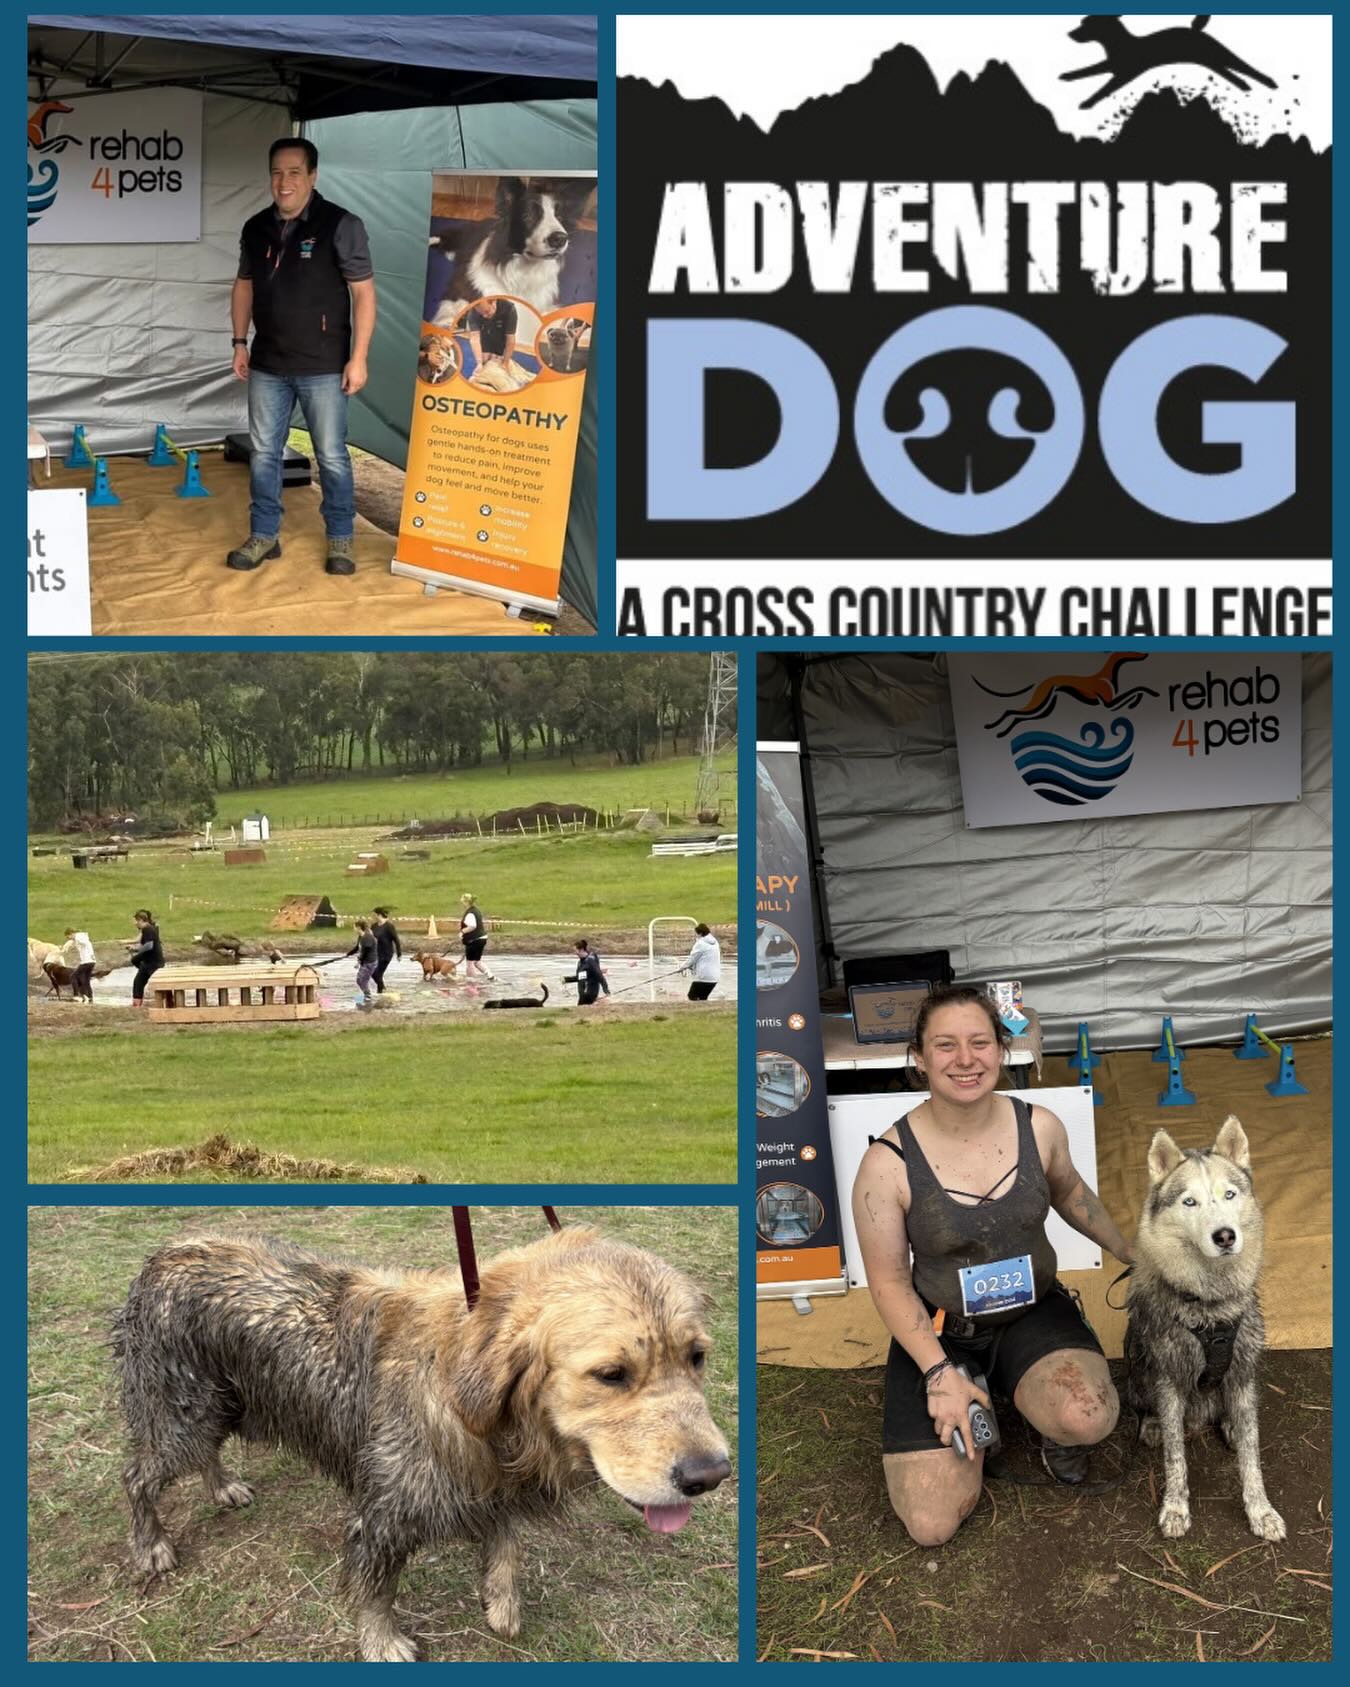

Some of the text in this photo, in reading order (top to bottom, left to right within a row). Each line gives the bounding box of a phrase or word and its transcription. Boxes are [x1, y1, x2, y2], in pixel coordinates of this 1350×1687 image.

[90, 128, 183, 160] rehab
[647, 181, 1288, 296] ADVENTURE
[422, 394, 568, 431] OSTEOPATHY
[646, 304, 1296, 536] DOG
[427, 438, 551, 465] gentle hands-on treatment
[431, 424, 550, 451] Osteopathy for dogs uses
[433, 451, 442, 459] to
[444, 453, 477, 465] reduce
[502, 463, 541, 478] improve
[426, 475, 543, 505] dog feel and move better.
[480, 472, 498, 482] and
[499, 475, 520, 489] help
[522, 482, 544, 492] your
[617, 586, 1333, 636] A CROSS COUNTRY CHALLENGE
[1168, 665, 1281, 711] rehab
[756, 1142, 795, 1154] Weight
[756, 1158, 796, 1169] gement
[974, 1271, 1024, 1295] 0232
